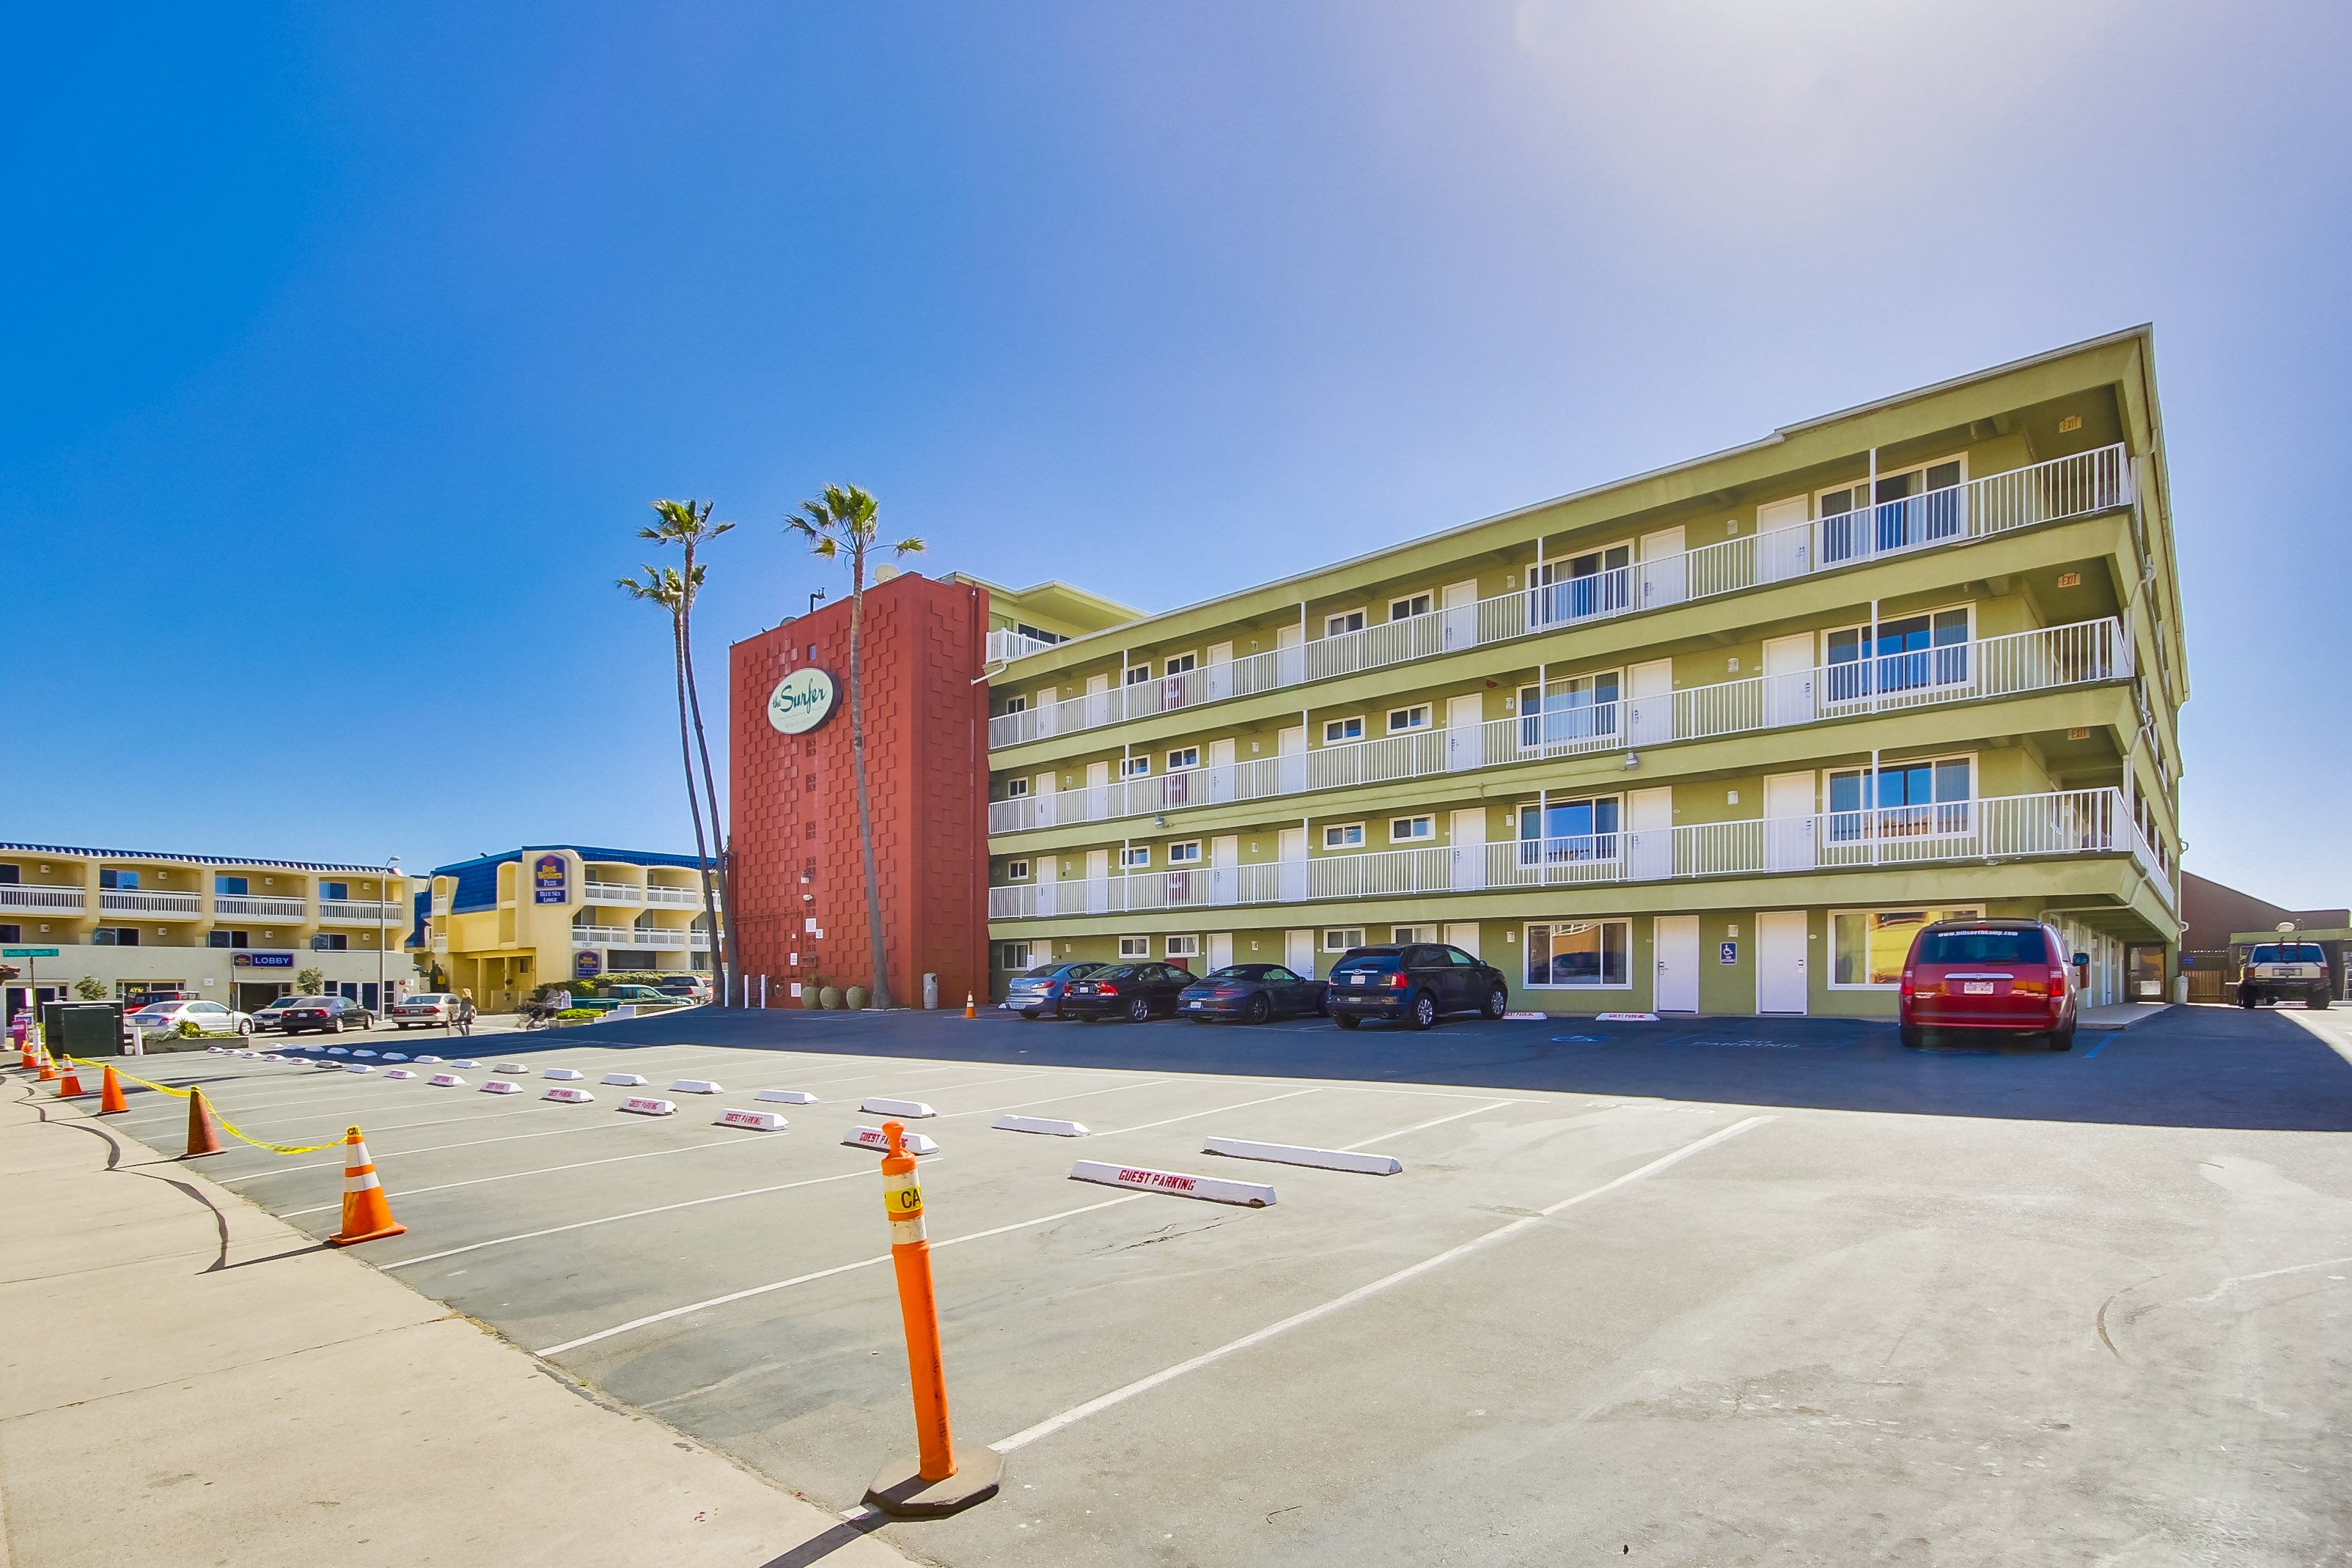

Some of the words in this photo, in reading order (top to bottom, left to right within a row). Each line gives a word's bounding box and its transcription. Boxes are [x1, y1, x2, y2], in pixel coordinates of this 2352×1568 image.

[2062, 419, 2078, 430] EXIT
[2062, 575, 2077, 586] EXIT
[772, 696, 782, 708] the
[780, 678, 827, 715] Surfer
[2071, 728, 2086, 739] EXIT
[628, 1100, 642, 1108] GUEST
[642, 1101, 658, 1110] PARKING
[725, 1113, 741, 1122] GUEST
[741, 1115, 762, 1125] PARKING
[859, 1132, 881, 1144] GUEST
[1118, 1169, 1152, 1184] GUEST
[1151, 1174, 1197, 1191] PARKING
